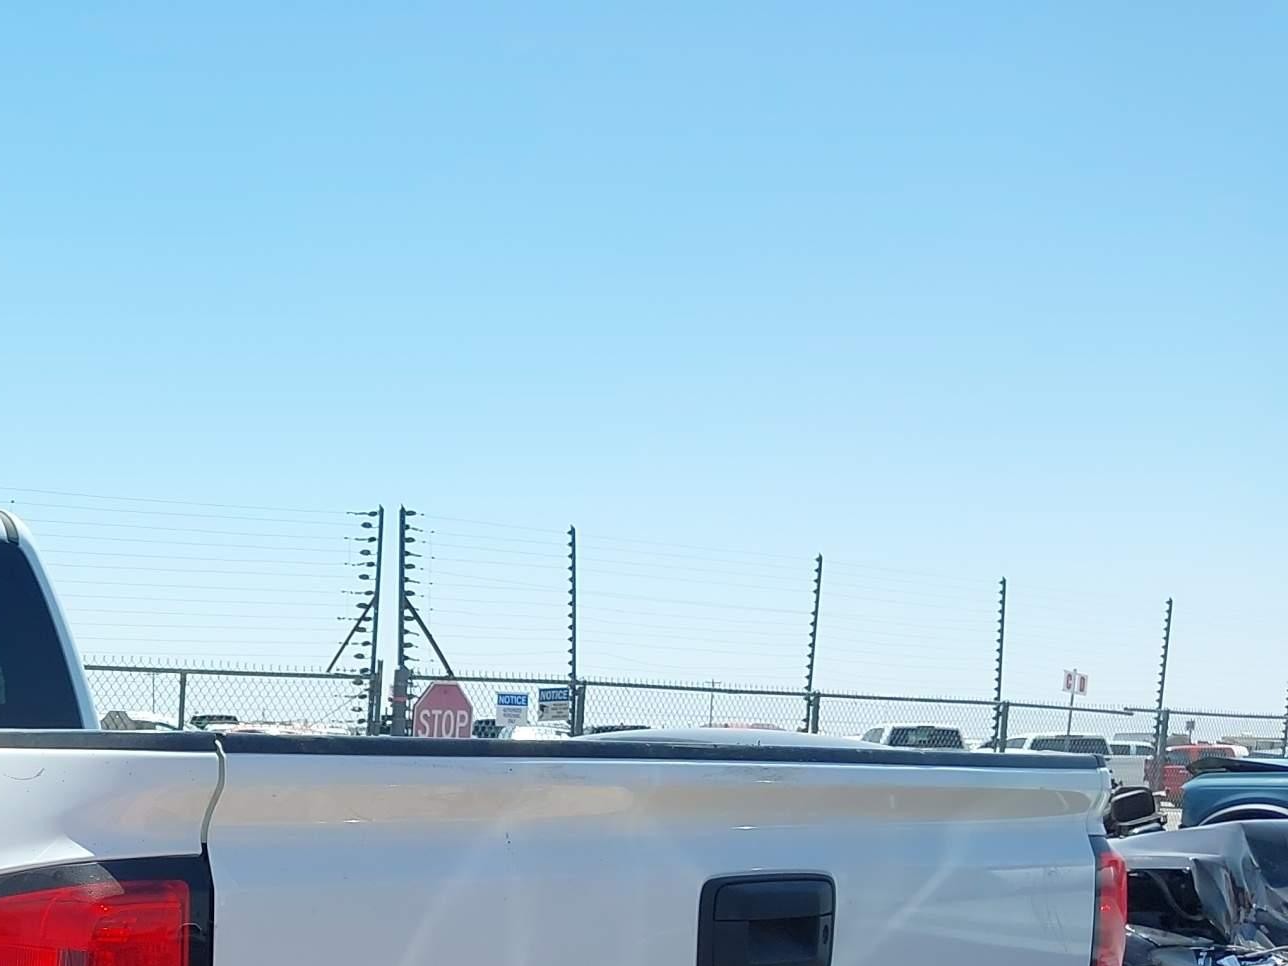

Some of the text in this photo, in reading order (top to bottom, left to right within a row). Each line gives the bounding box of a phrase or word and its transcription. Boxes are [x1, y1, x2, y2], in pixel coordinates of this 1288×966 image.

[498, 695, 527, 705] NOTICE
[540, 690, 568, 701] NOTICE
[418, 710, 468, 738] STOP
